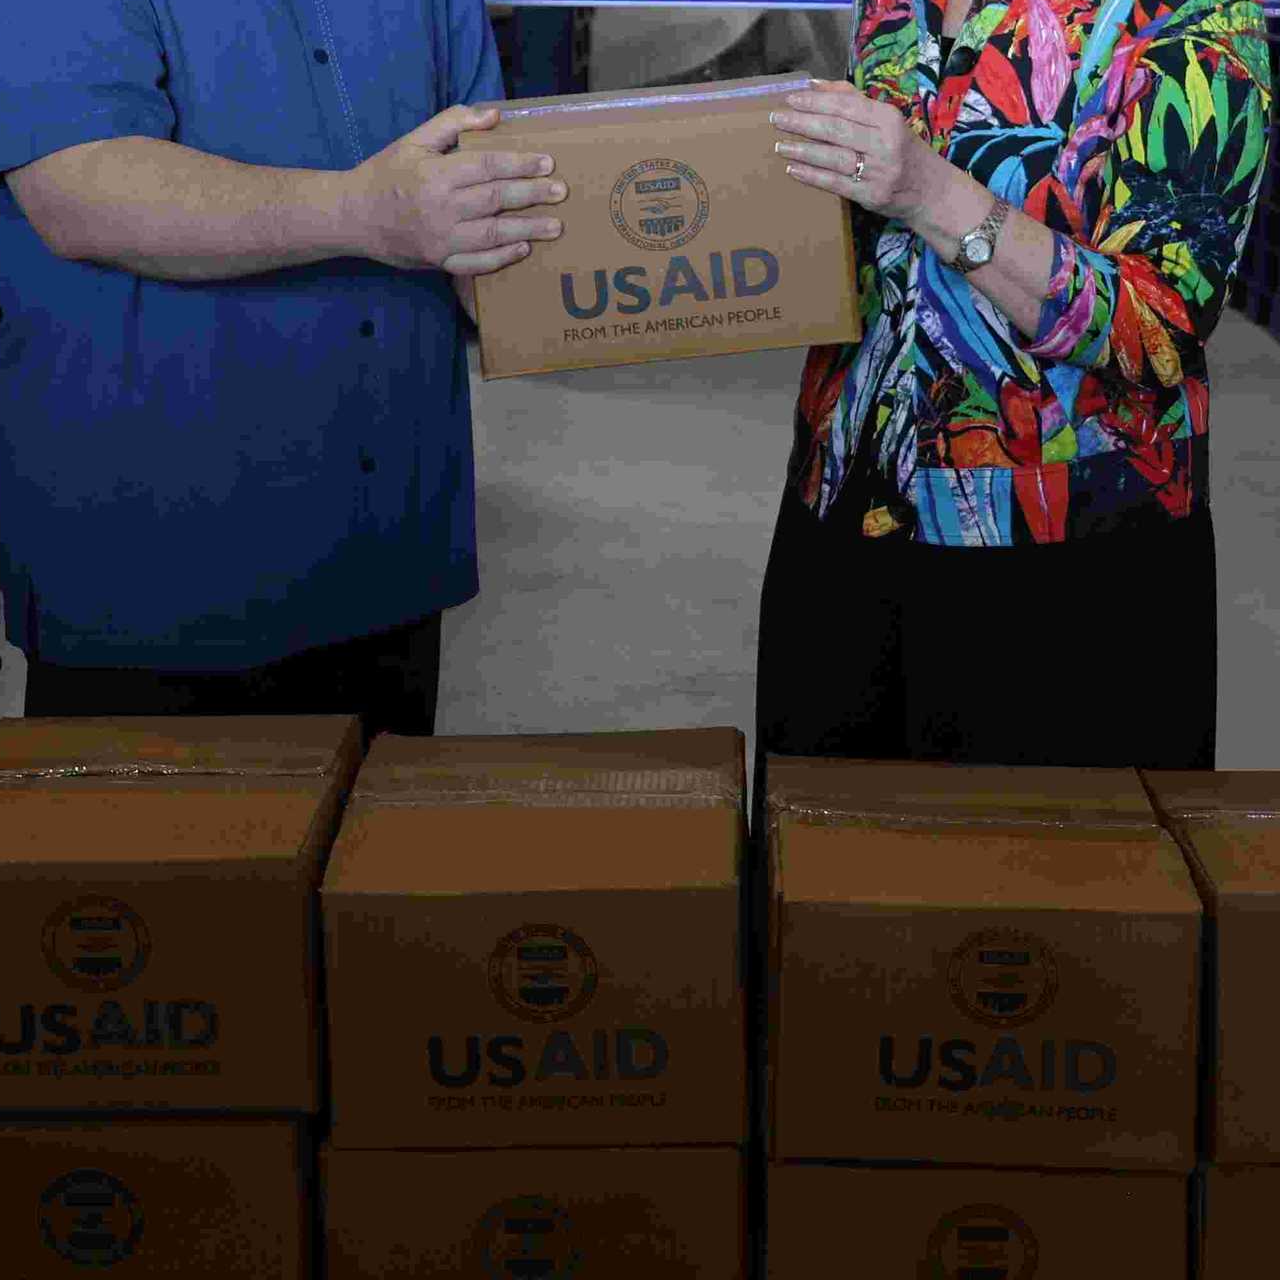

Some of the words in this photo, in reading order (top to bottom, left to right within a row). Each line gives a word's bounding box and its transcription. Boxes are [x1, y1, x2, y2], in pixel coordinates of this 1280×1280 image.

[560, 247, 780, 320] USAID
[563, 324, 608, 342] FROM
[609, 321, 640, 337] THE
[644, 313, 725, 334] AMERICAN
[726, 305, 782, 326] PEOPLE
[428, 1028, 670, 1088] USAID
[880, 1035, 1118, 1092] USAID
